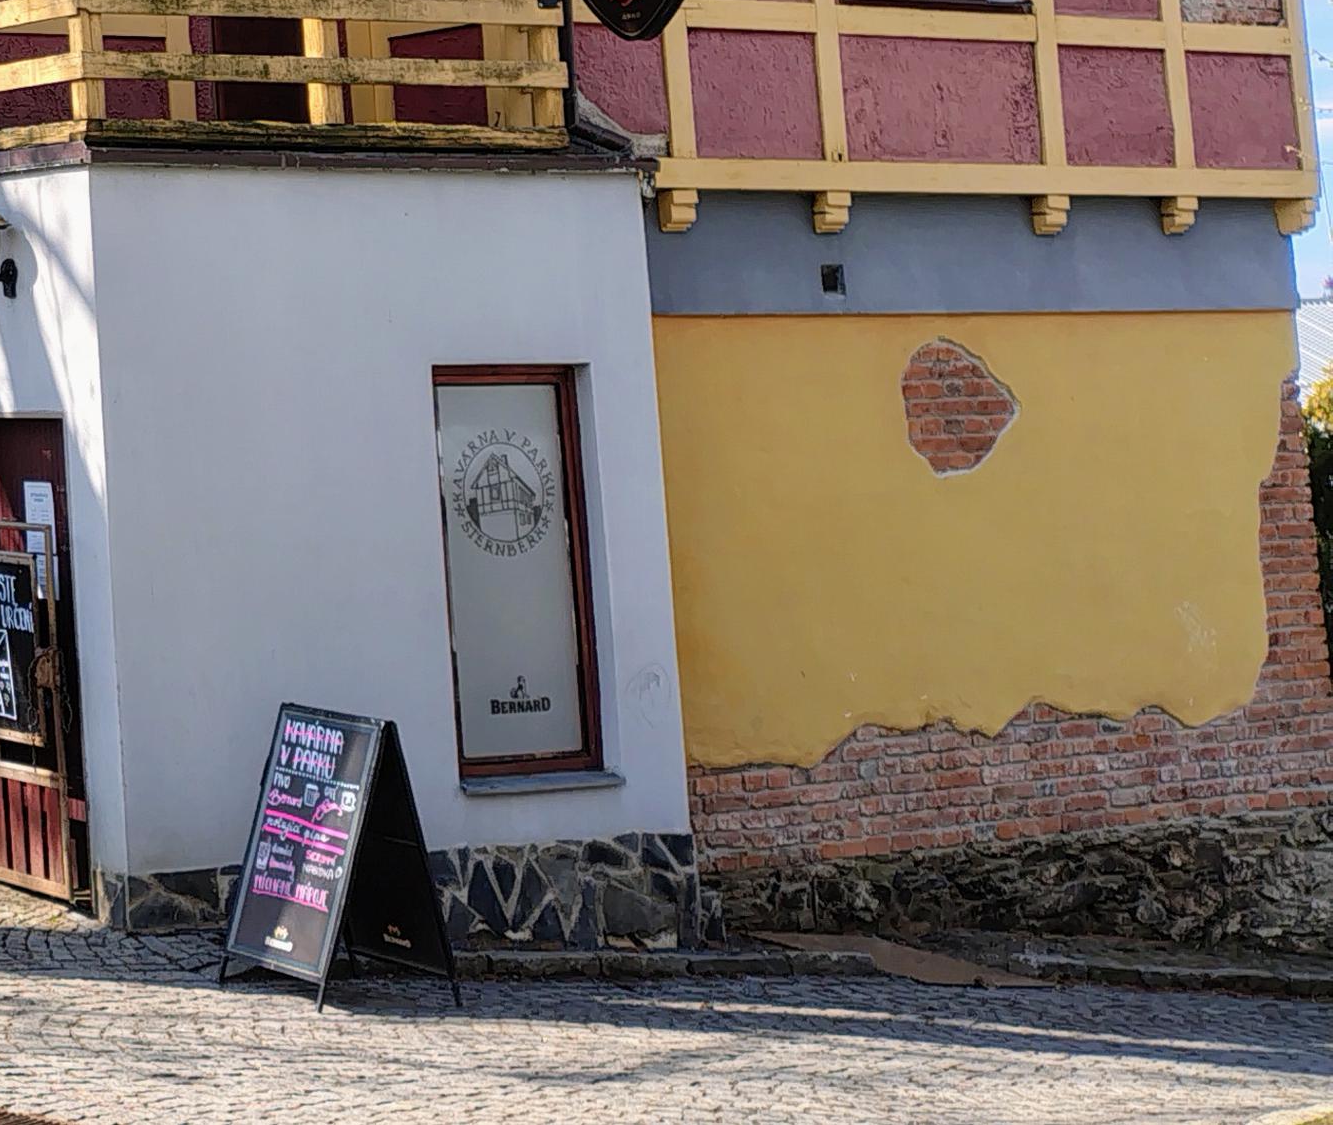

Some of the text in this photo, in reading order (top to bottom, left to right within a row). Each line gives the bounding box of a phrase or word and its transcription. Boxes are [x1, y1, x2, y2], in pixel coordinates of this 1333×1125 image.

[504, 428, 516, 442] V
[521, 436, 555, 497] PARKU
[490, 696, 551, 715] BERNARD
[284, 719, 344, 755] KAVÁRNA
[280, 744, 336, 779] V PARKU
[273, 772, 291, 789] PIVO
